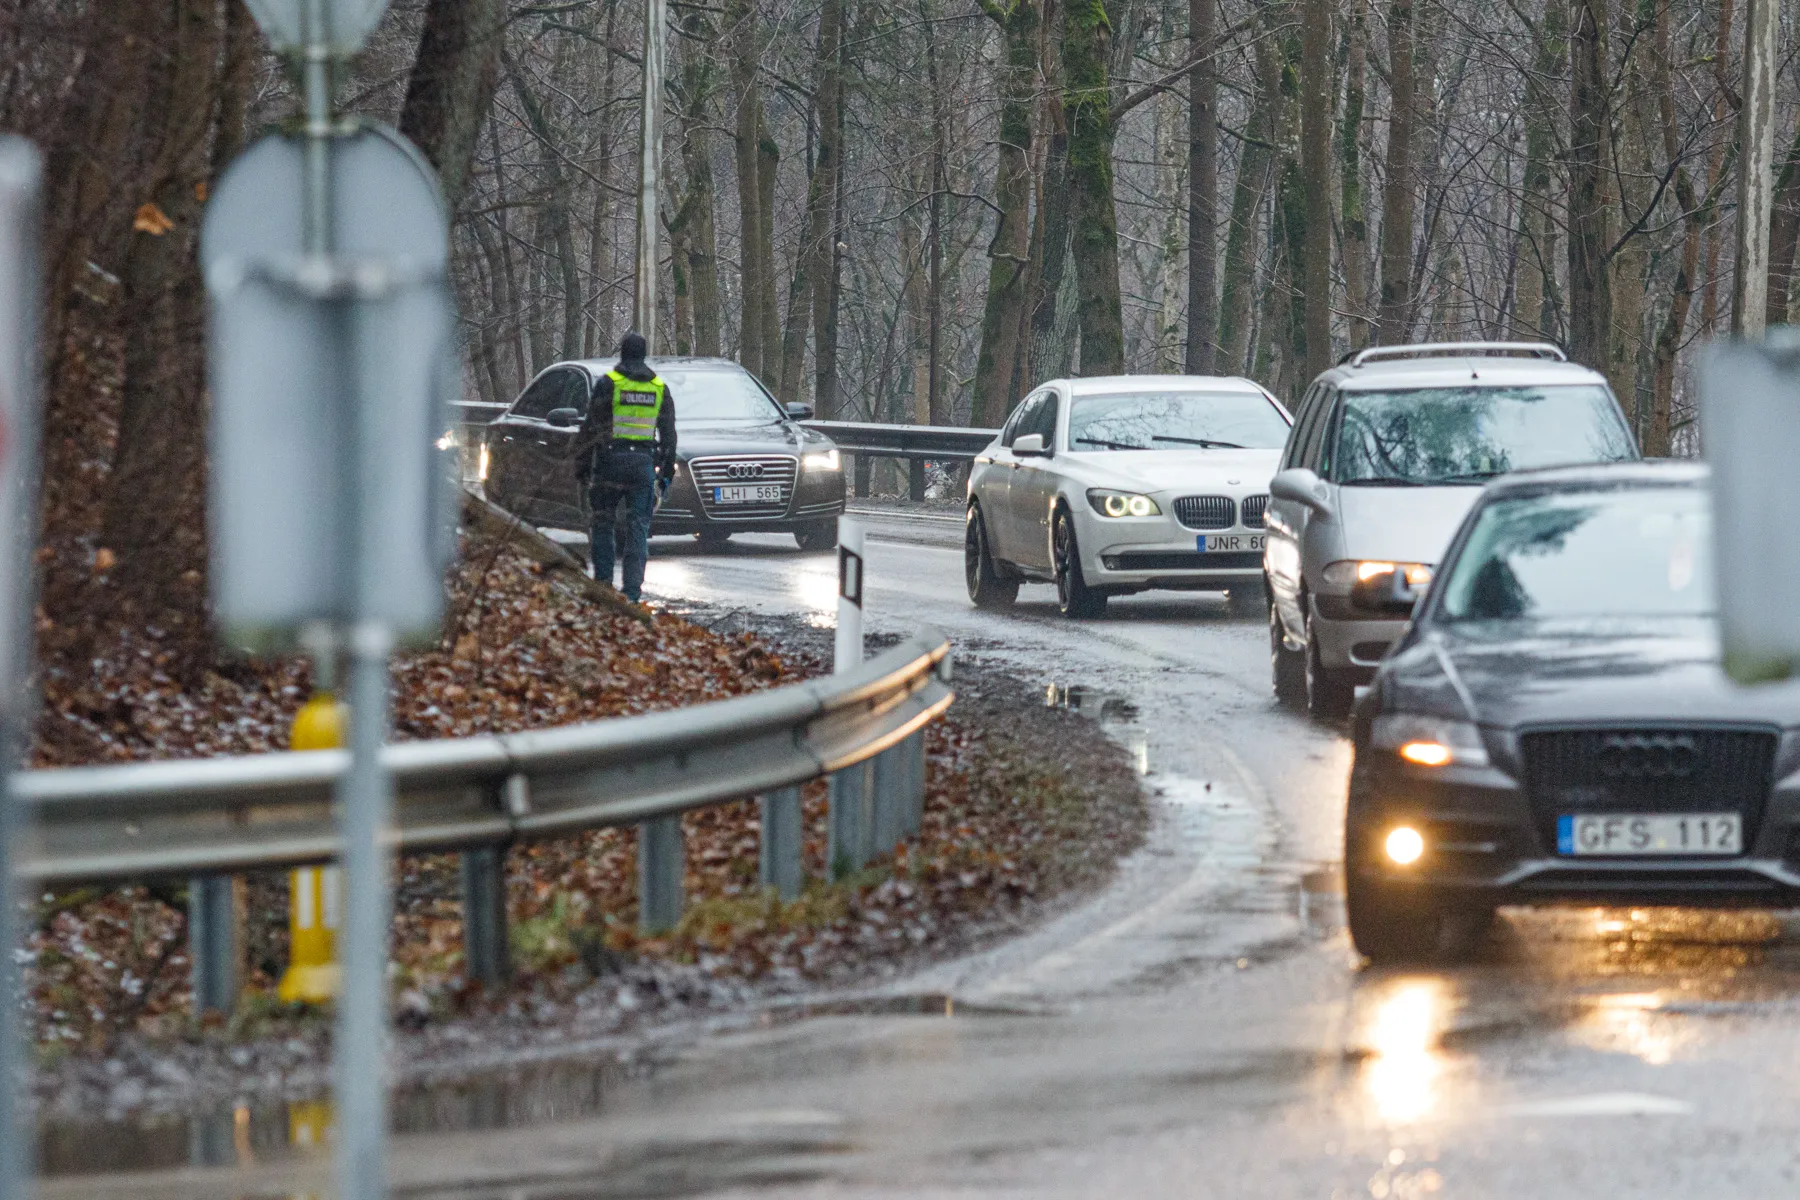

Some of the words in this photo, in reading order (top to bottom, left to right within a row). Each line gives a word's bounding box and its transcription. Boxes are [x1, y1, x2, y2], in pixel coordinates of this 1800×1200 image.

[722, 488, 746, 500] LHI
[756, 487, 779, 498] 565
[1208, 536, 1240, 550] JNR
[1250, 536, 1265, 549] 60
[1577, 817, 1652, 849] GFS
[1676, 818, 1736, 849] 112
